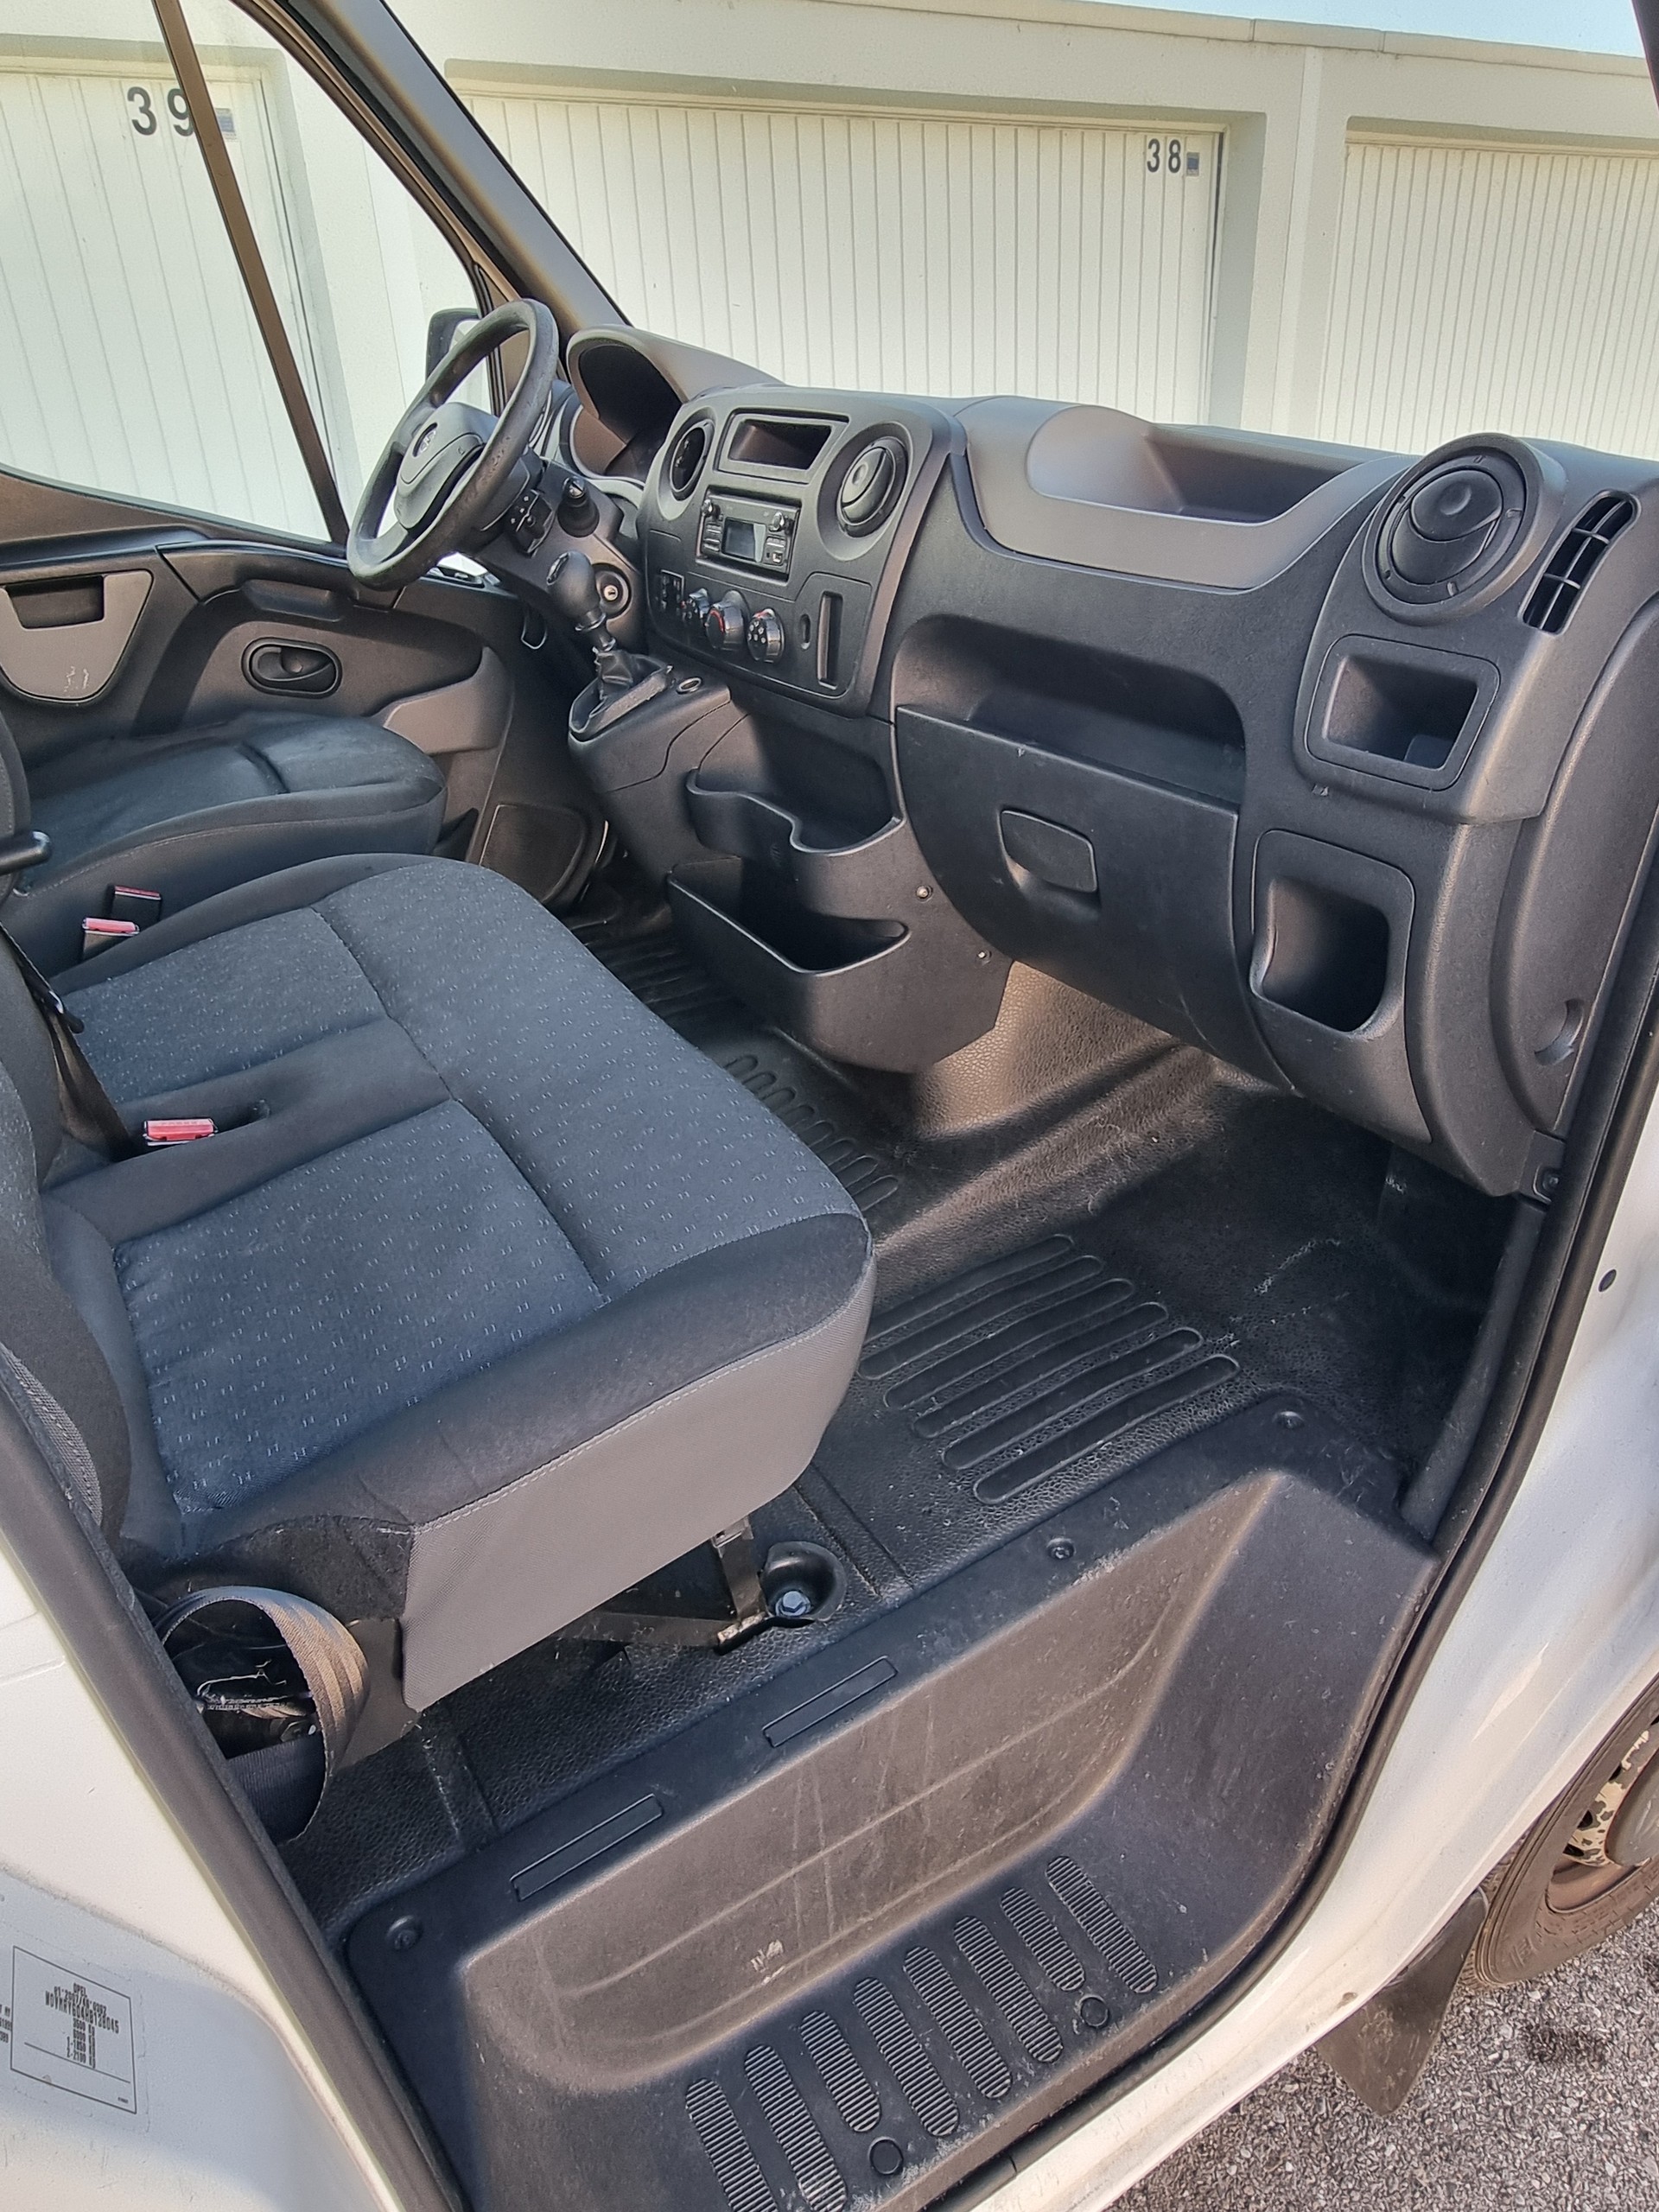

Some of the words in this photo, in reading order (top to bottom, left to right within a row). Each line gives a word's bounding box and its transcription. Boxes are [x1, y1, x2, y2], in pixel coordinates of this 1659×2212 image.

[127, 86, 194, 137] 39
[1147, 138, 1181, 174] 38
[73, 1982, 88, 1998] OPEL
